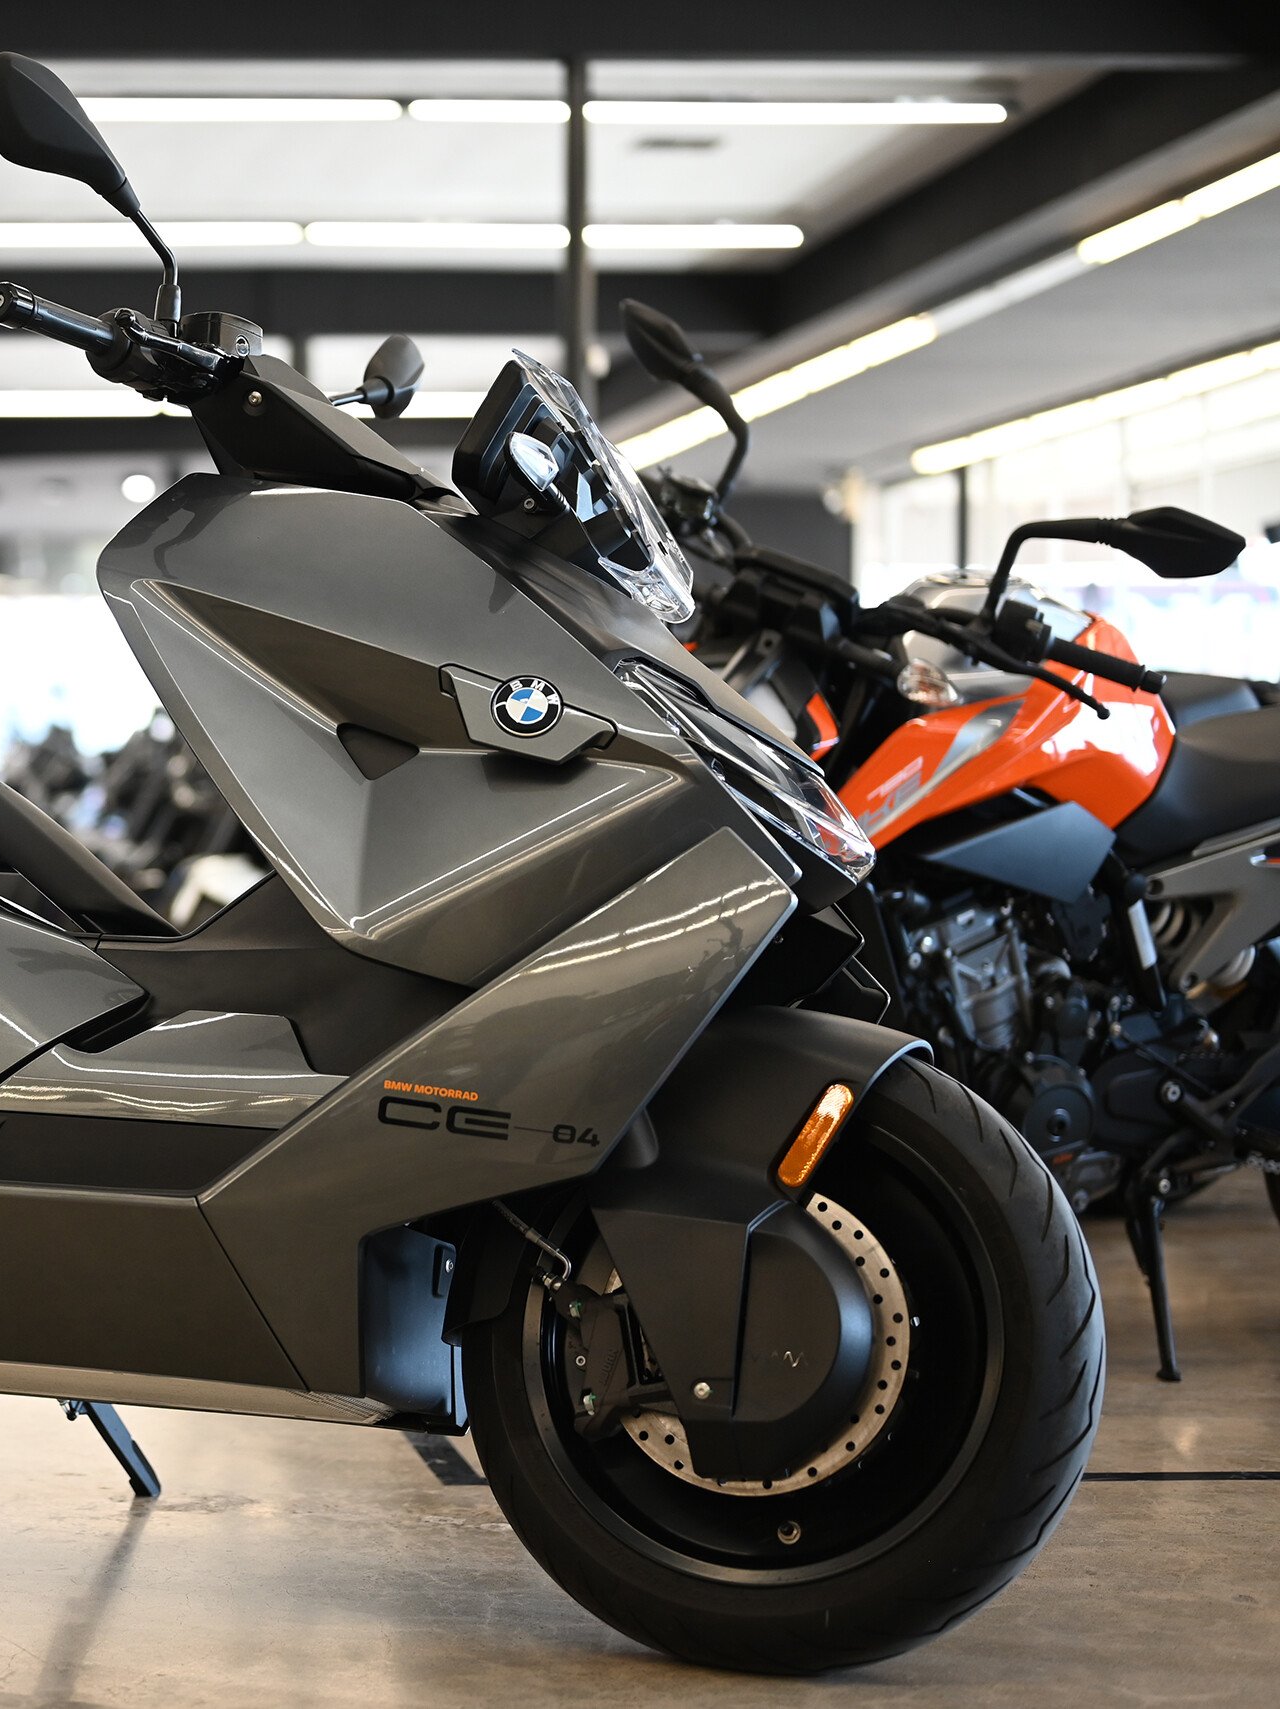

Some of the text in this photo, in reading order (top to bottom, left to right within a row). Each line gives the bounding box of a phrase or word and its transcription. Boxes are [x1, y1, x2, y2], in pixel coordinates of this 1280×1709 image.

[508, 679, 559, 705] BMW
[383, 1079, 479, 1101] BMW MOTORRAD
[377, 1095, 600, 1148] CE 04
